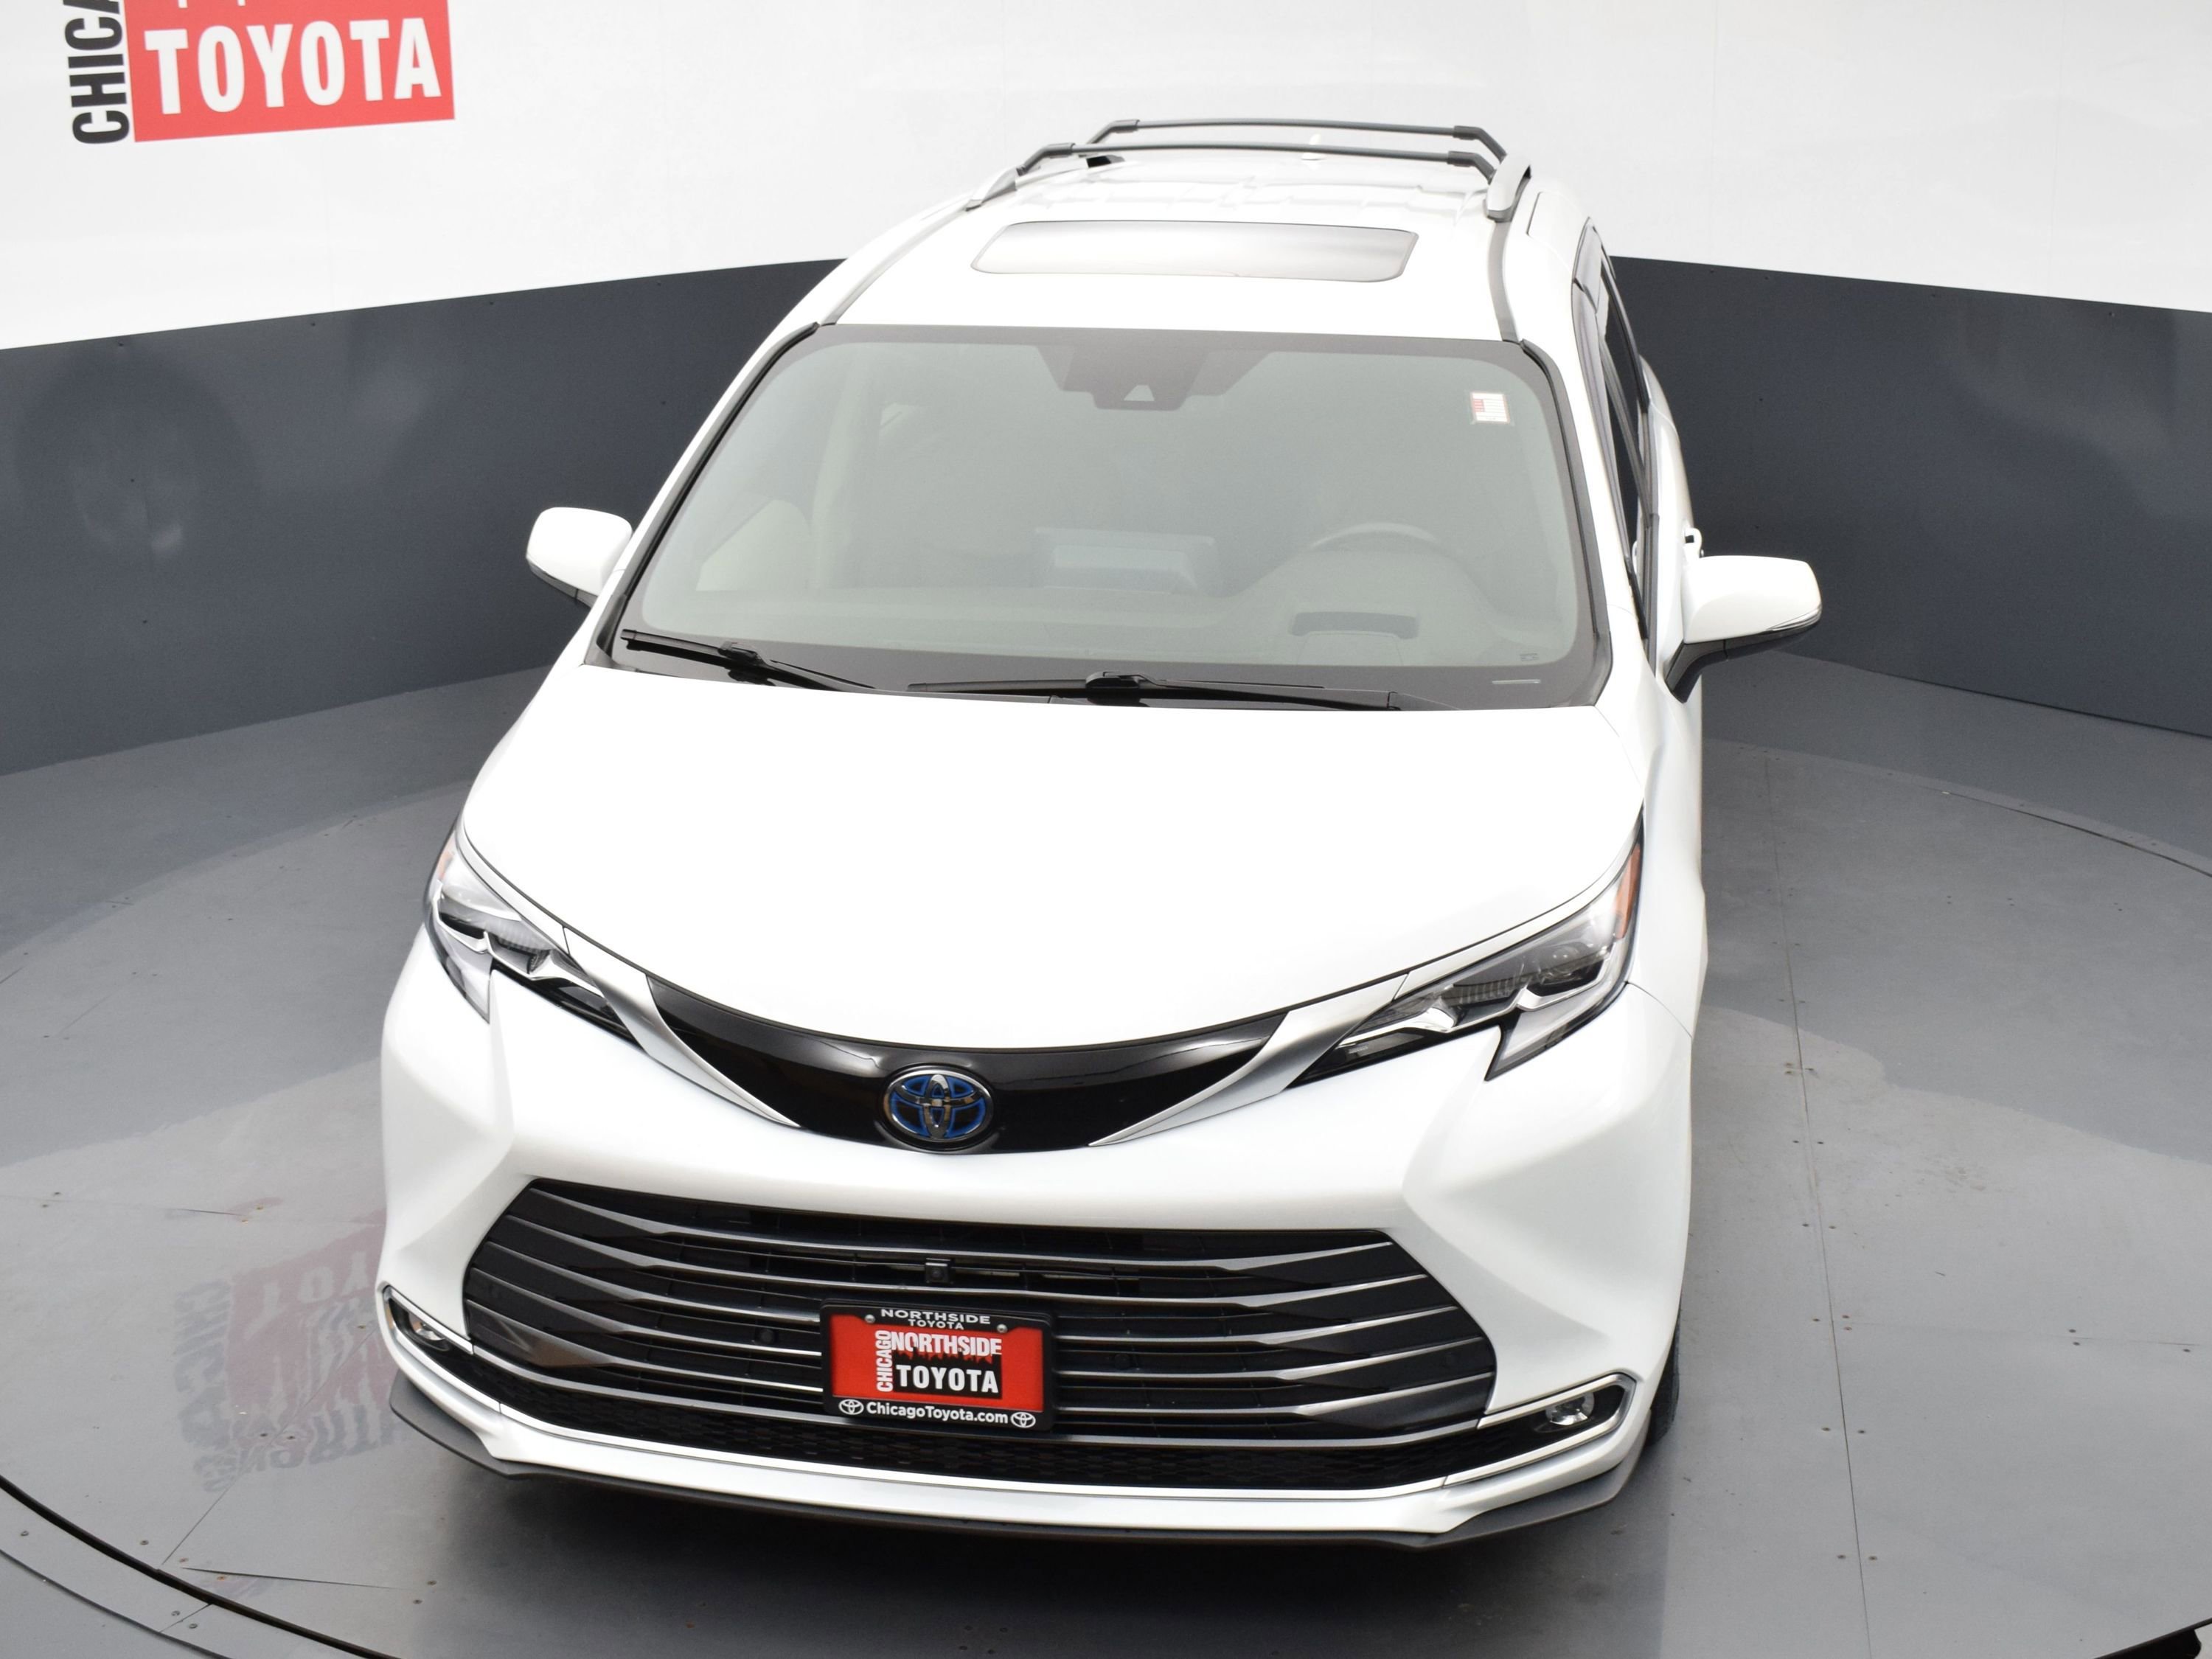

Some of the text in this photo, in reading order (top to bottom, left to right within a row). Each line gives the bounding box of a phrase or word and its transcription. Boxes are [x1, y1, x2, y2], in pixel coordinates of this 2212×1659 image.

[145, 17, 442, 115] TOYOTA
[880, 1309, 991, 1324] NORTHSIDE
[908, 1318, 964, 1330] TOYOTA
[891, 1331, 1003, 1357] NORTHSIDE
[874, 1329, 894, 1392] CHICAGO
[896, 1364, 999, 1394] TOYOTA
[866, 1401, 1009, 1424] ChicagoToyota.com
